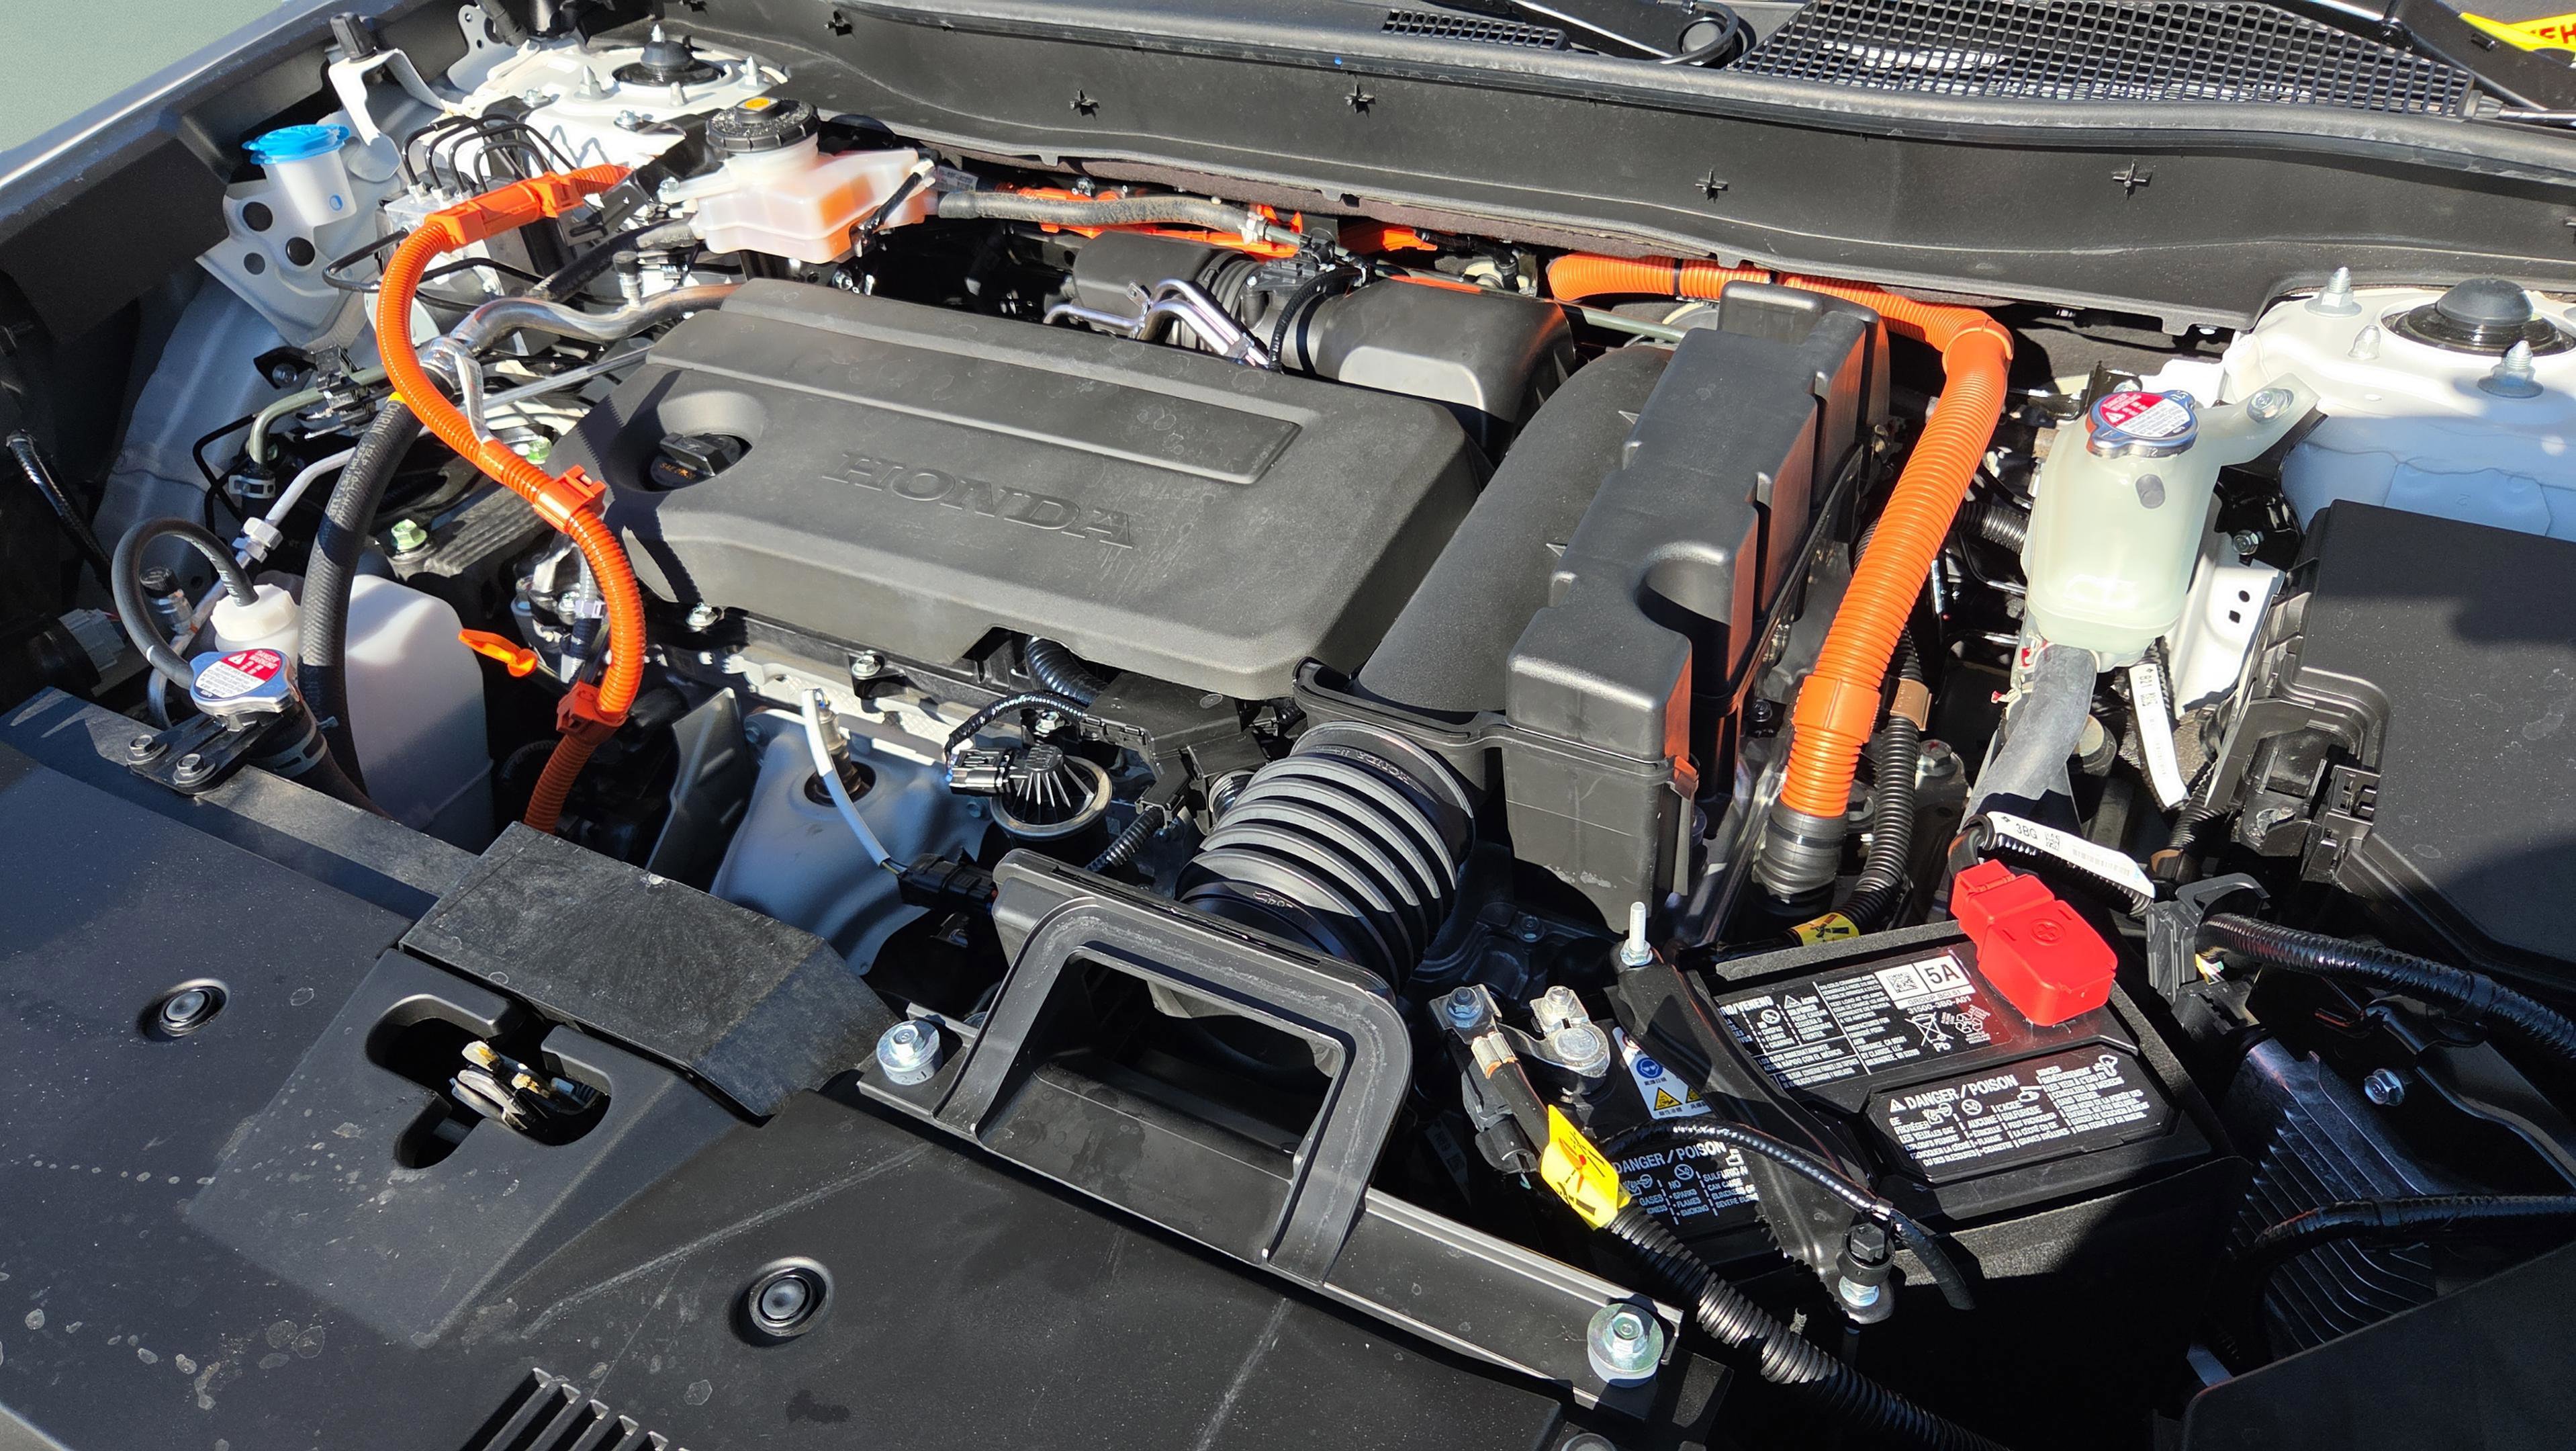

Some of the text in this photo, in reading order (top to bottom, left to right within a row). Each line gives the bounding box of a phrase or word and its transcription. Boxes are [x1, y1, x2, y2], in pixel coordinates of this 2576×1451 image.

[821, 452, 1135, 549] HONDA
[2015, 823, 2039, 841] 3BG
[1924, 963, 1961, 984] 5A
[1907, 995, 1972, 1014] 31500-3B0-A01
[1933, 1041, 1951, 1053] Pb
[1668, 1180, 1682, 1190] NO
